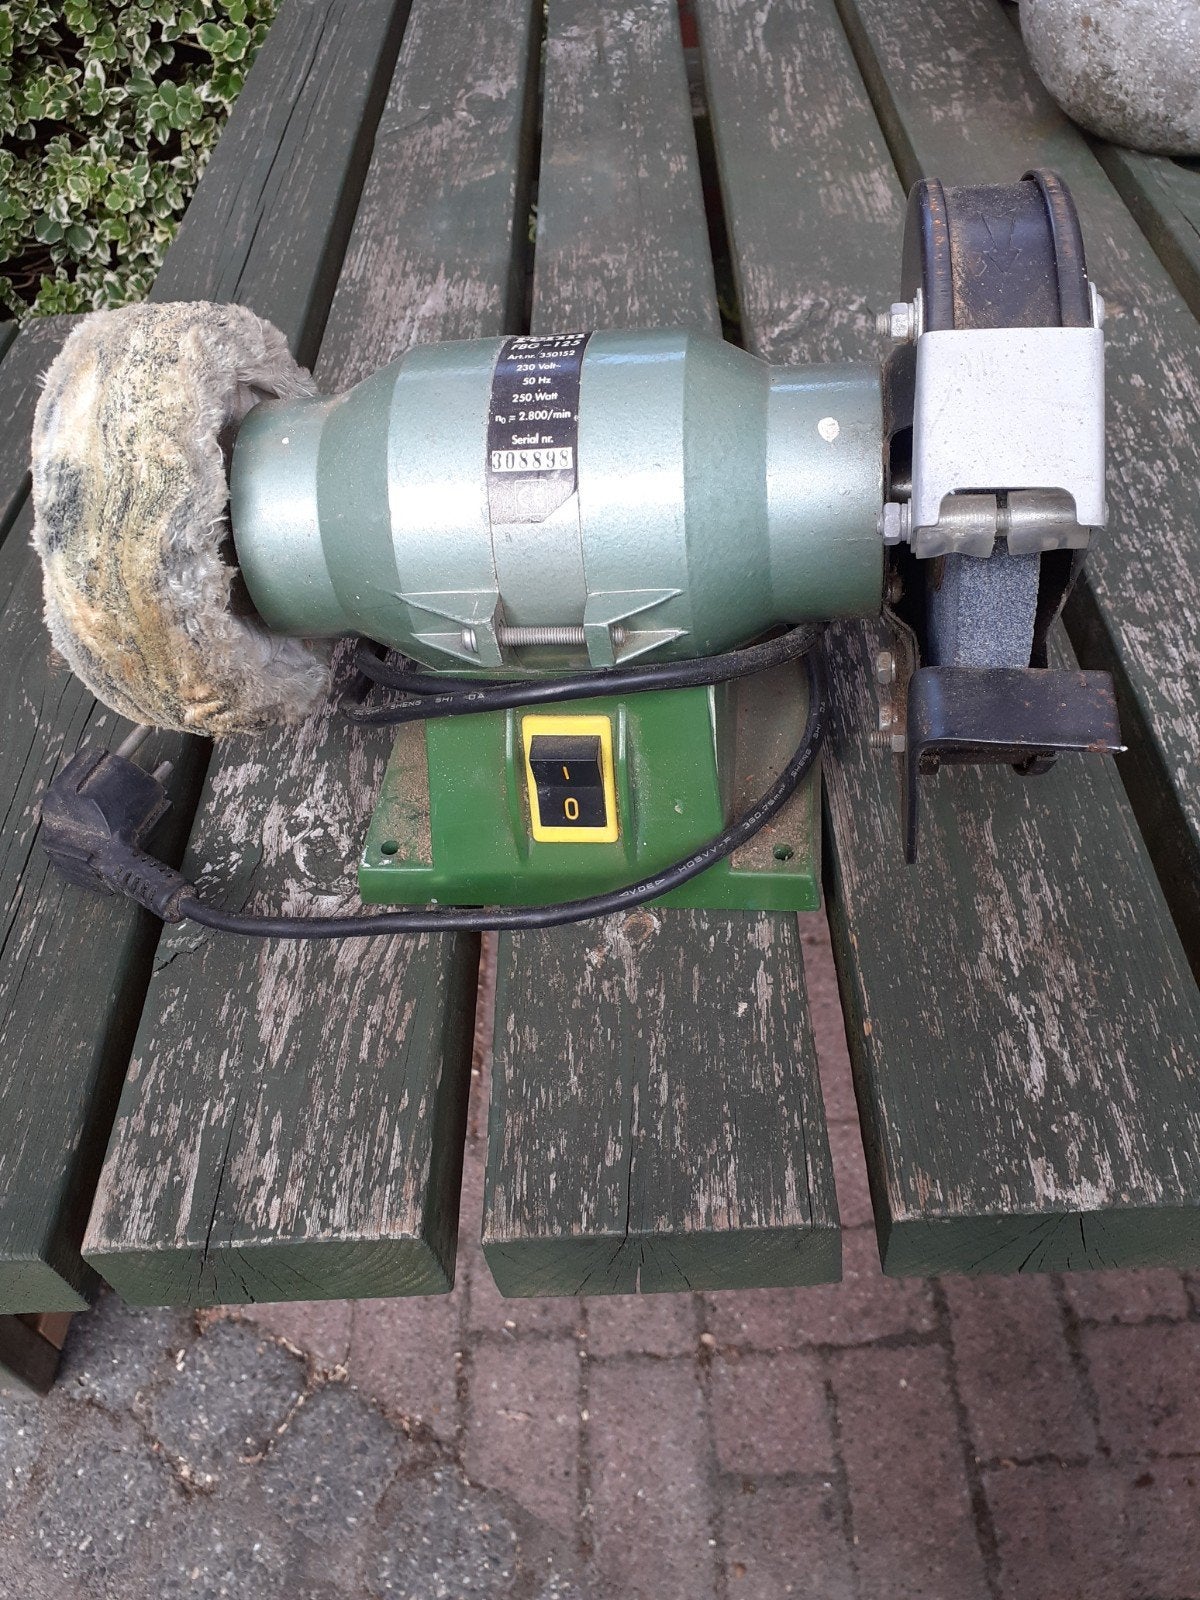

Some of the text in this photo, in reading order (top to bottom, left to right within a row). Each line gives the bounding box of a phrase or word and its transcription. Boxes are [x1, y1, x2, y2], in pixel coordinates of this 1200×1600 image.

[539, 350, 576, 359] 350152
[516, 363, 536, 372] 230
[522, 376, 552, 386] 50 Hz
[512, 391, 559, 403] 250 Watt
[518, 409, 572, 421] 2.800/min
[511, 432, 554, 445] Serial nr.
[492, 449, 569, 470] 308898
[790, 748, 812, 778] SHENG
